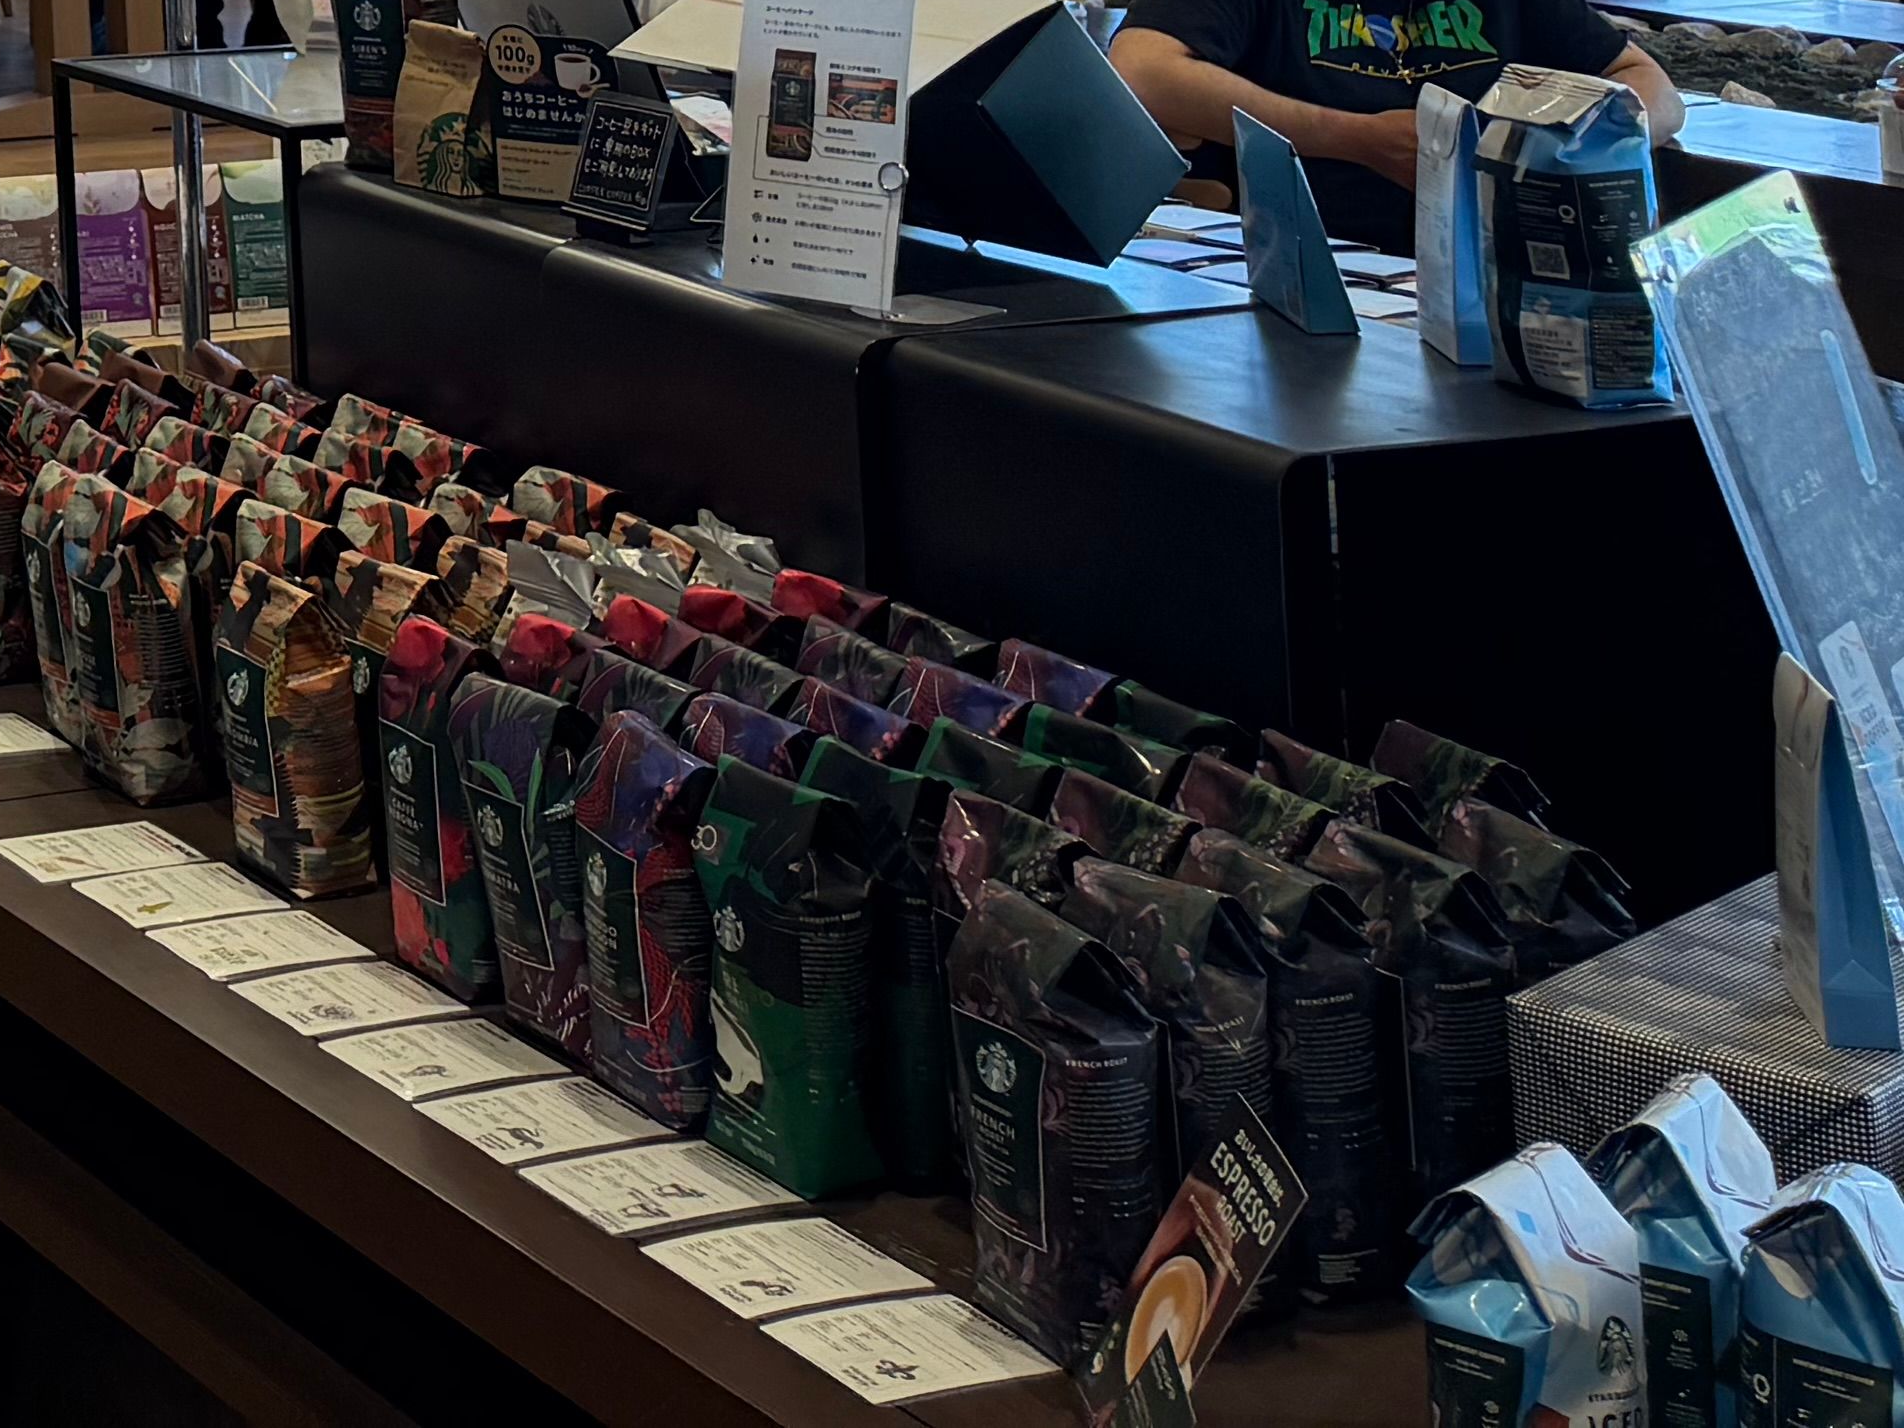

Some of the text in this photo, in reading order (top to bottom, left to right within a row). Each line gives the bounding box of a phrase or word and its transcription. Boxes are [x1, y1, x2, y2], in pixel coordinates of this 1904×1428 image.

[495, 45, 534, 66] 100g
[1352, 62, 1449, 78] REVTA
[502, 90, 578, 106] おうちコーヒー
[503, 107, 586, 123] はじめませんか
[232, 213, 265, 222] MATCHA
[1065, 1058, 1102, 1069] FRENCH
[970, 1105, 1015, 1141] FRENCH
[1210, 1141, 1276, 1246] ESPRESSO
[1215, 1194, 1246, 1244] ROAST
